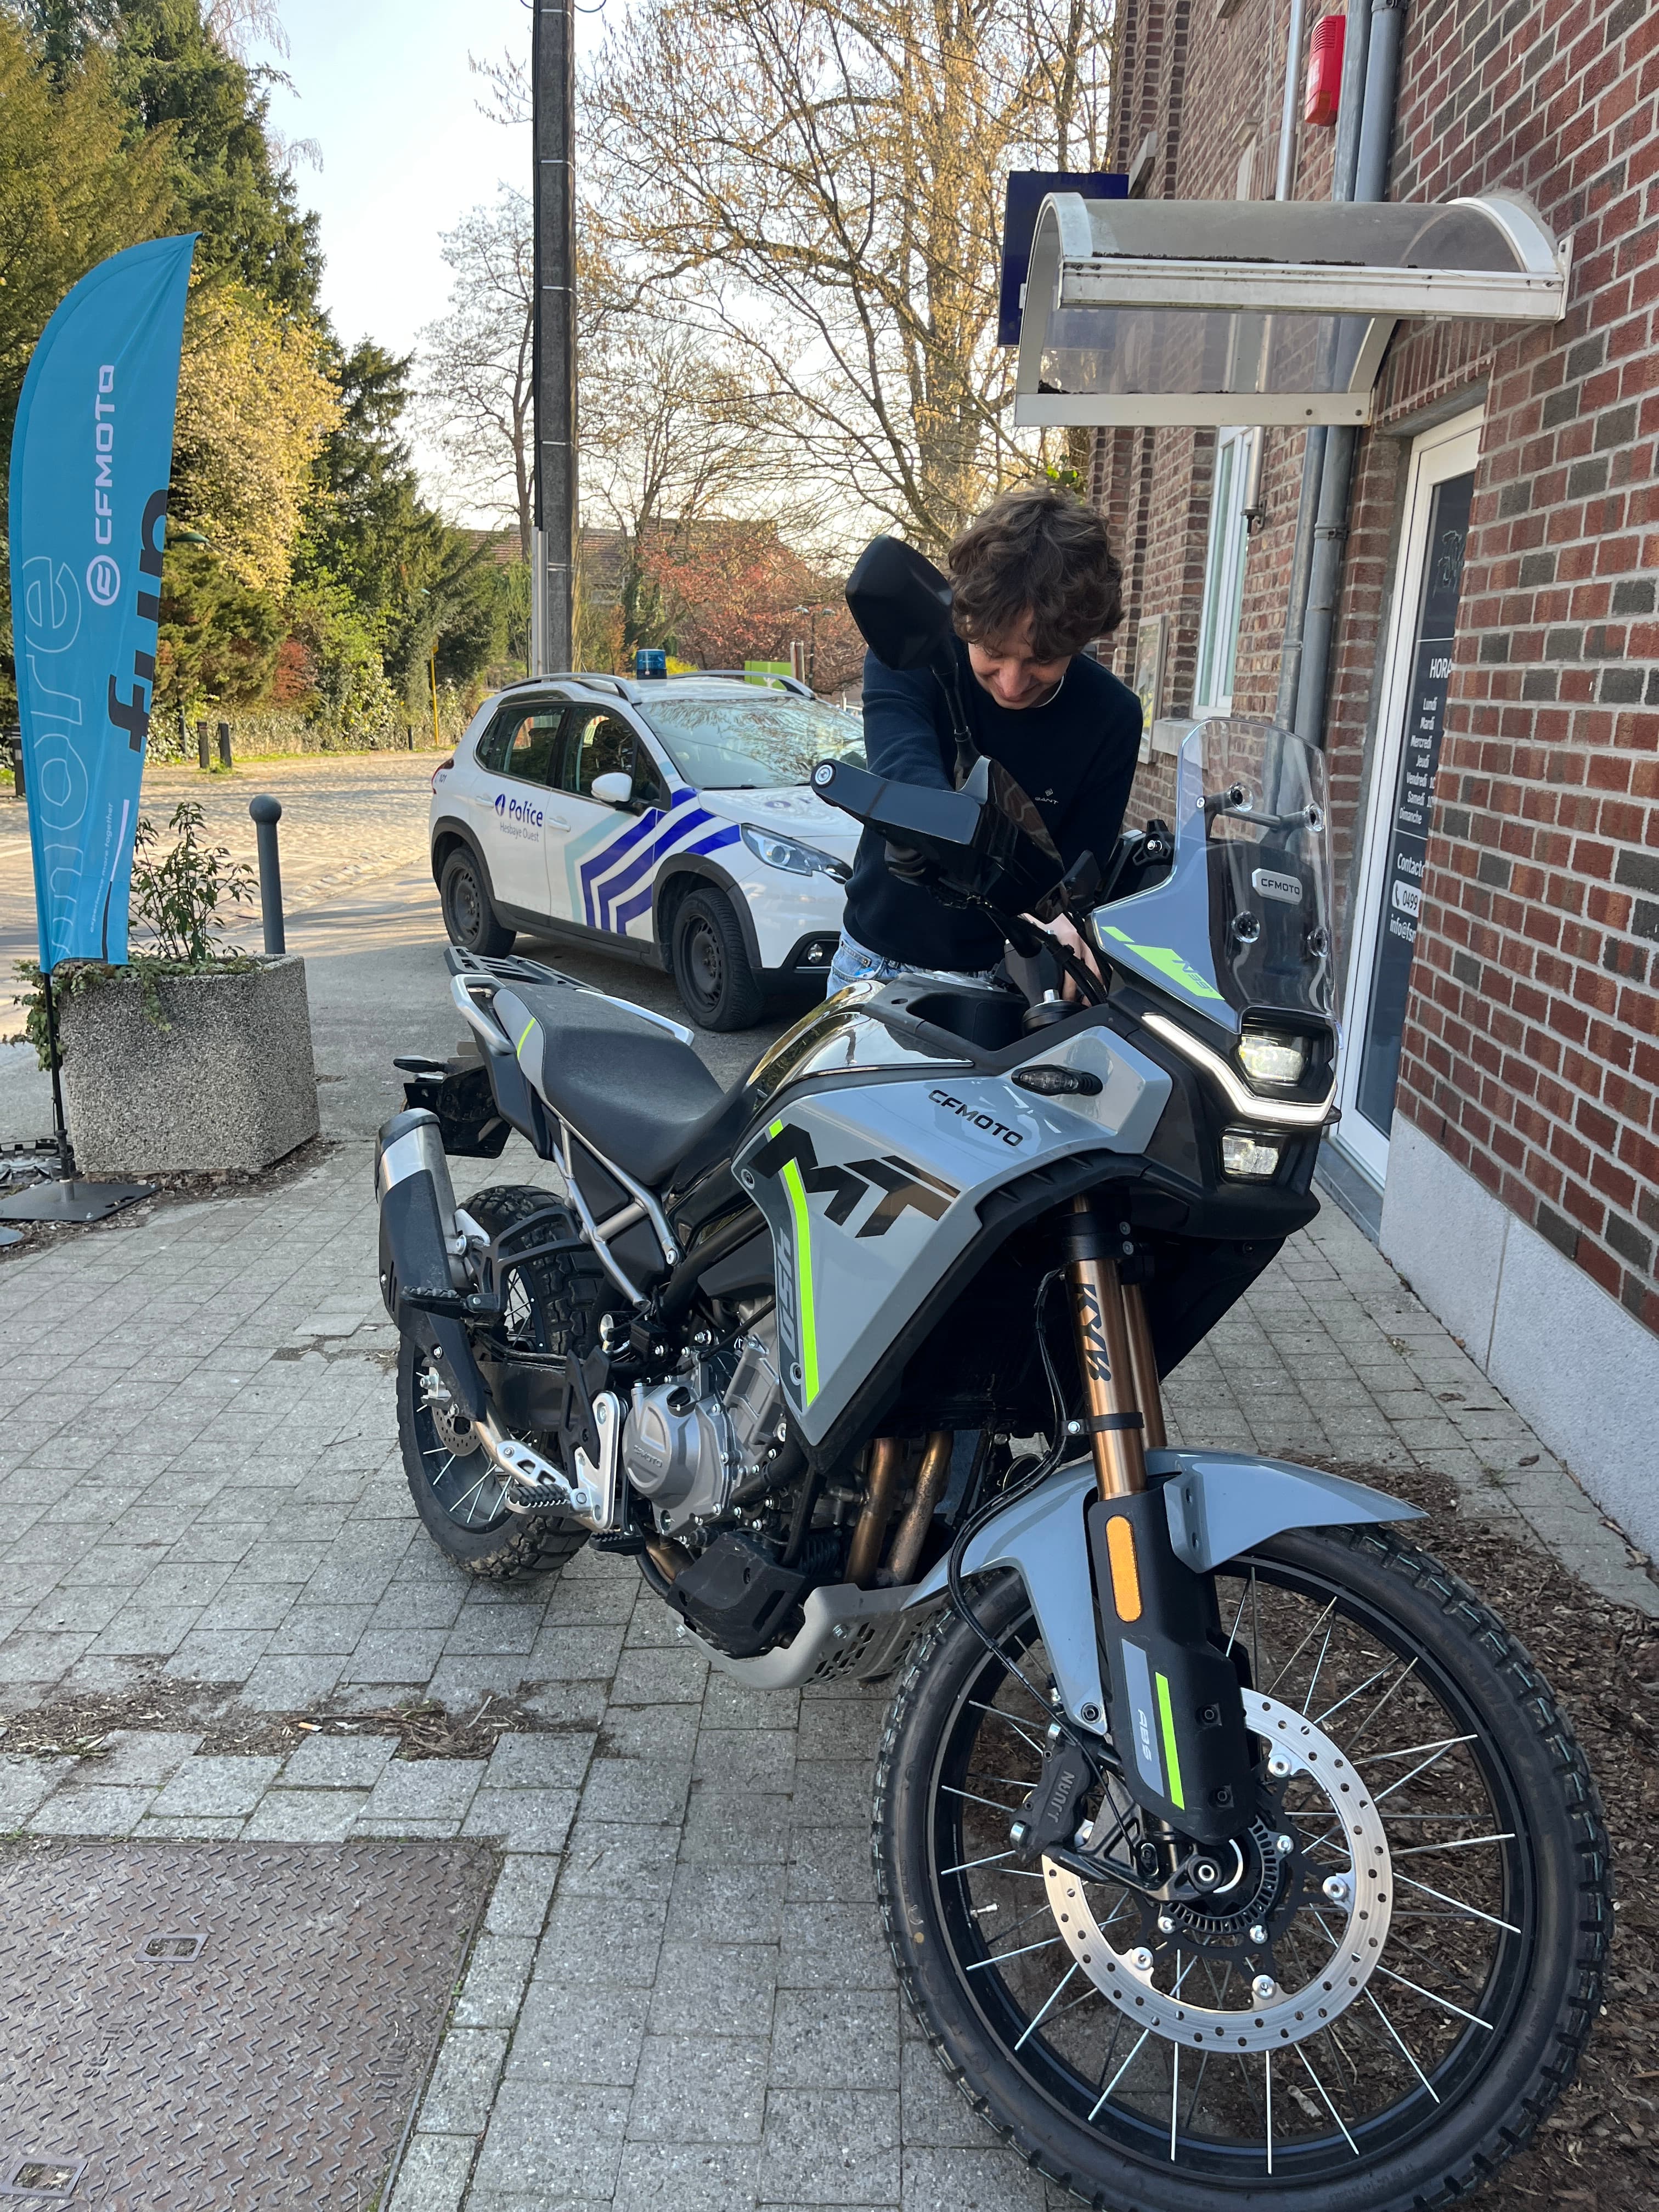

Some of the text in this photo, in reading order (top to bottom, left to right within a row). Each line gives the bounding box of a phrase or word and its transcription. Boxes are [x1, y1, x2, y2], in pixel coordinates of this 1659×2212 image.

[95, 365, 115, 544] CFMOTO
[1423, 696, 1438, 711] Lundi
[1420, 715, 1435, 730] Mardi
[1410, 735, 1433, 749] Mercredi
[1416, 754, 1430, 768] Jeudi
[1407, 771, 1428, 787] Vendredi
[1407, 791, 1425, 806] Samedi
[509, 799, 543, 827] Police
[1400, 806, 1422, 825] Dimanche
[500, 822, 539, 842] Hesbaye Ouest
[1261, 878, 1300, 895] CFMOTO
[1402, 890, 1418, 911] 0499
[928, 1090, 1023, 1147] CFMOTO
[747, 1124, 961, 1238] MT
[1073, 1283, 1111, 1381] KYB
[1138, 1708, 1152, 1762] ABS
